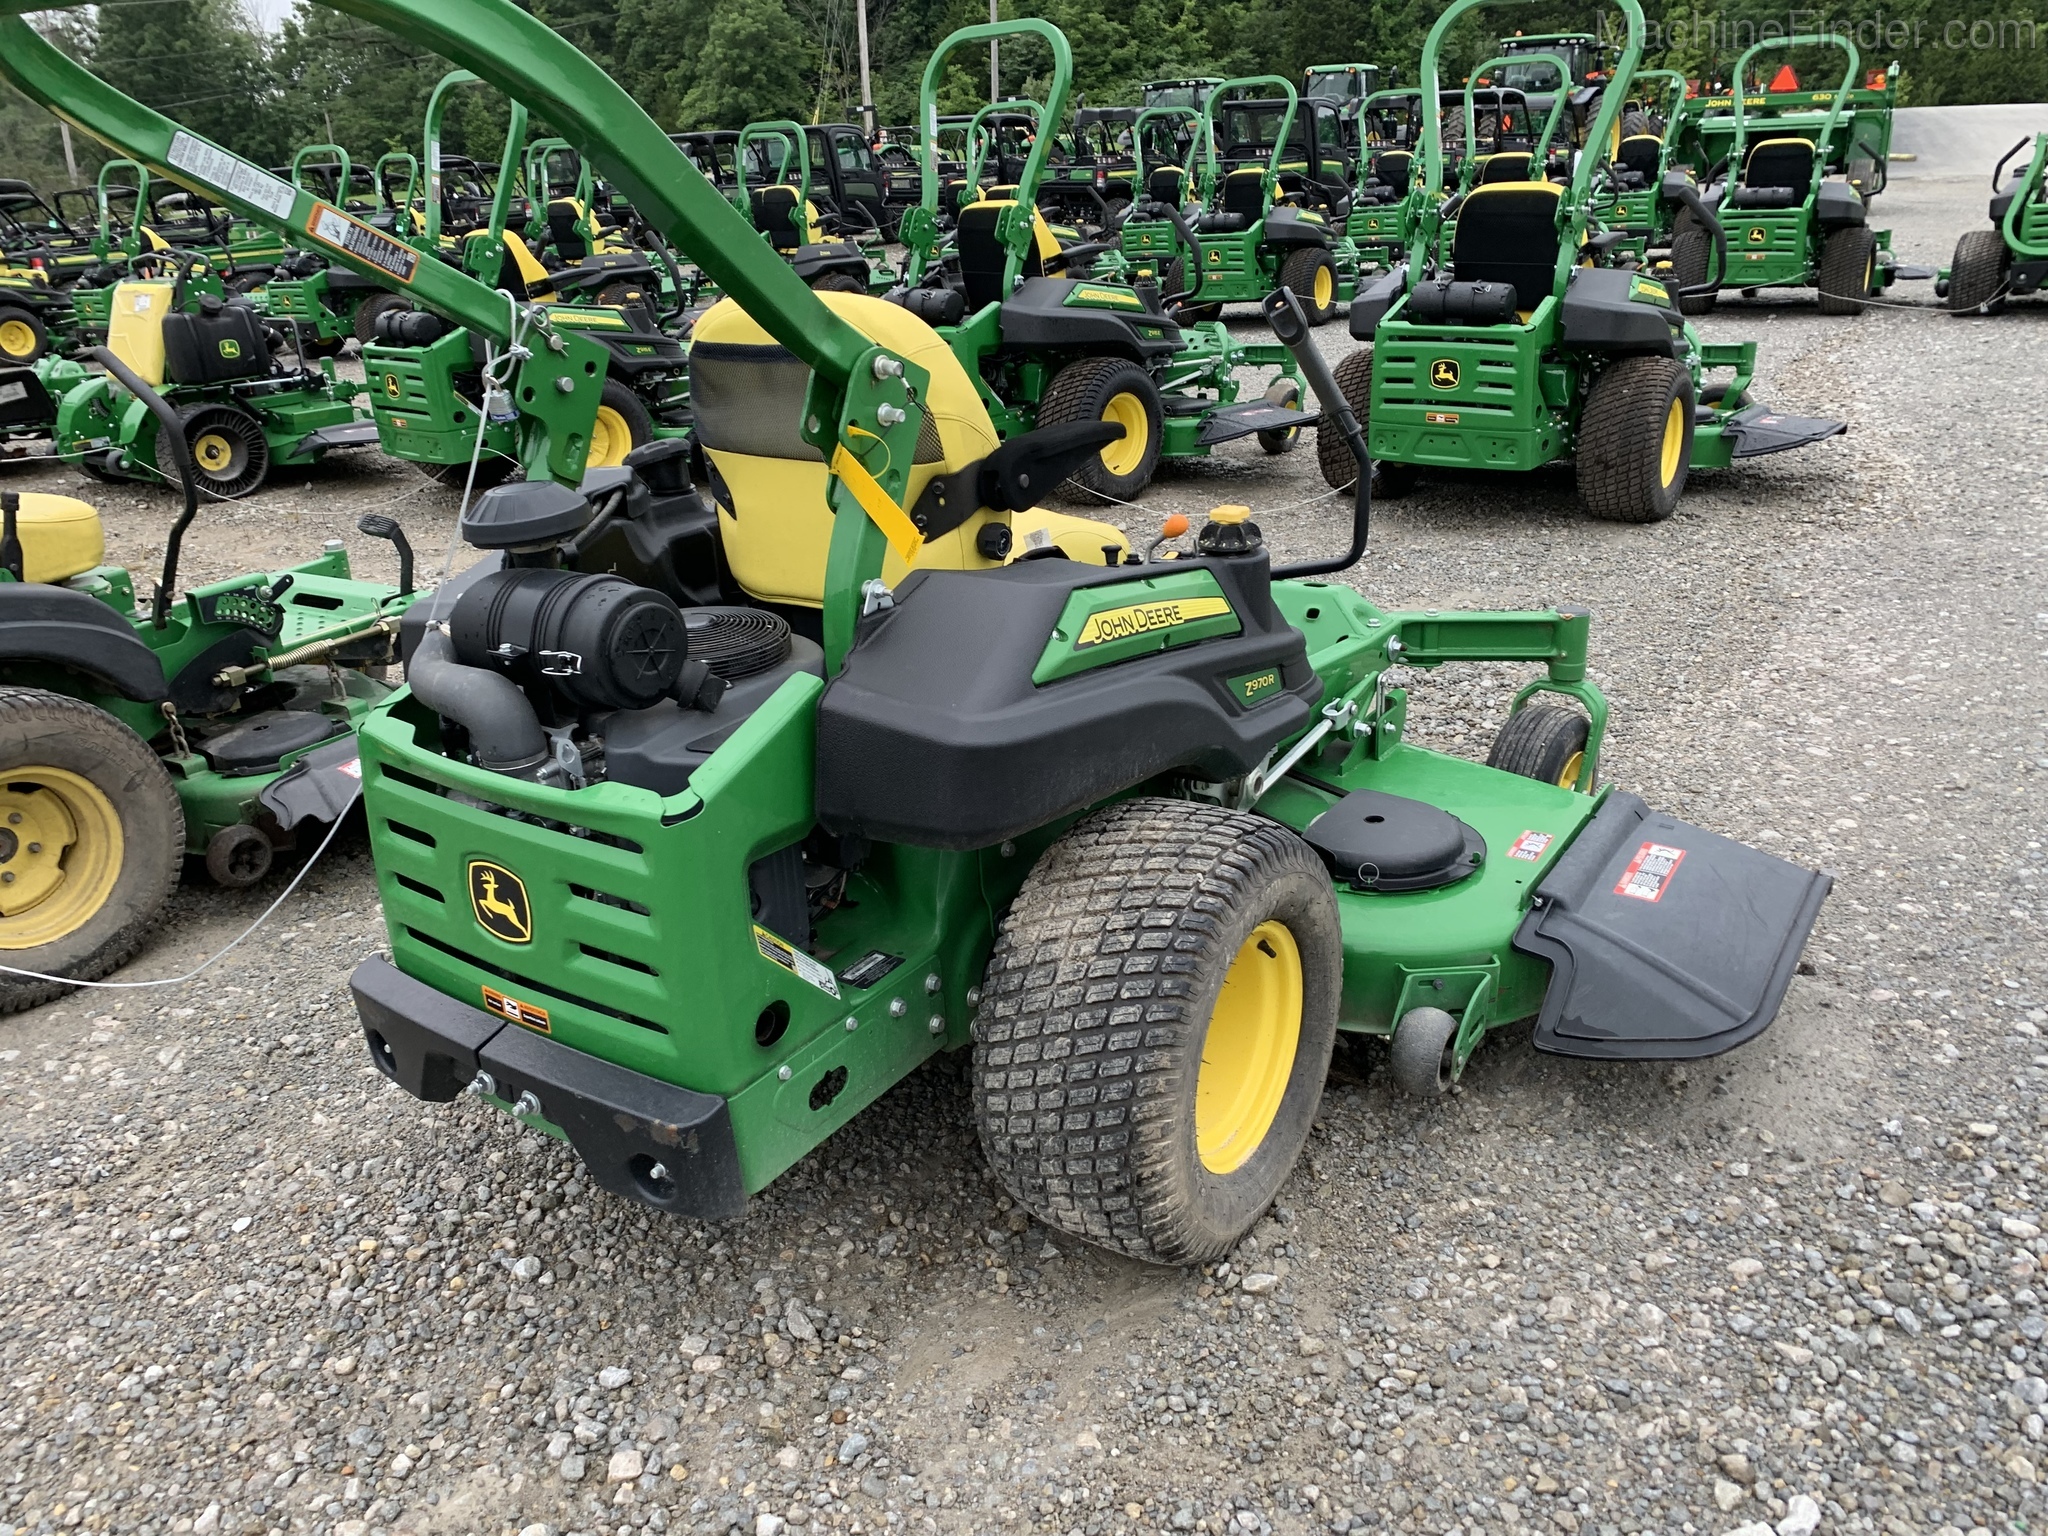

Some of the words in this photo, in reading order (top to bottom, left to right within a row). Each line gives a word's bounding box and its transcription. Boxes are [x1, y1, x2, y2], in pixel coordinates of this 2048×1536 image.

[1705, 99, 1732, 107] JOHN
[1733, 97, 1767, 106] EERE
[1812, 93, 1832, 101] 630
[1093, 614, 1134, 641] JOHN
[1133, 605, 1183, 629] DEERE
[1245, 674, 1275, 697] Z970R
